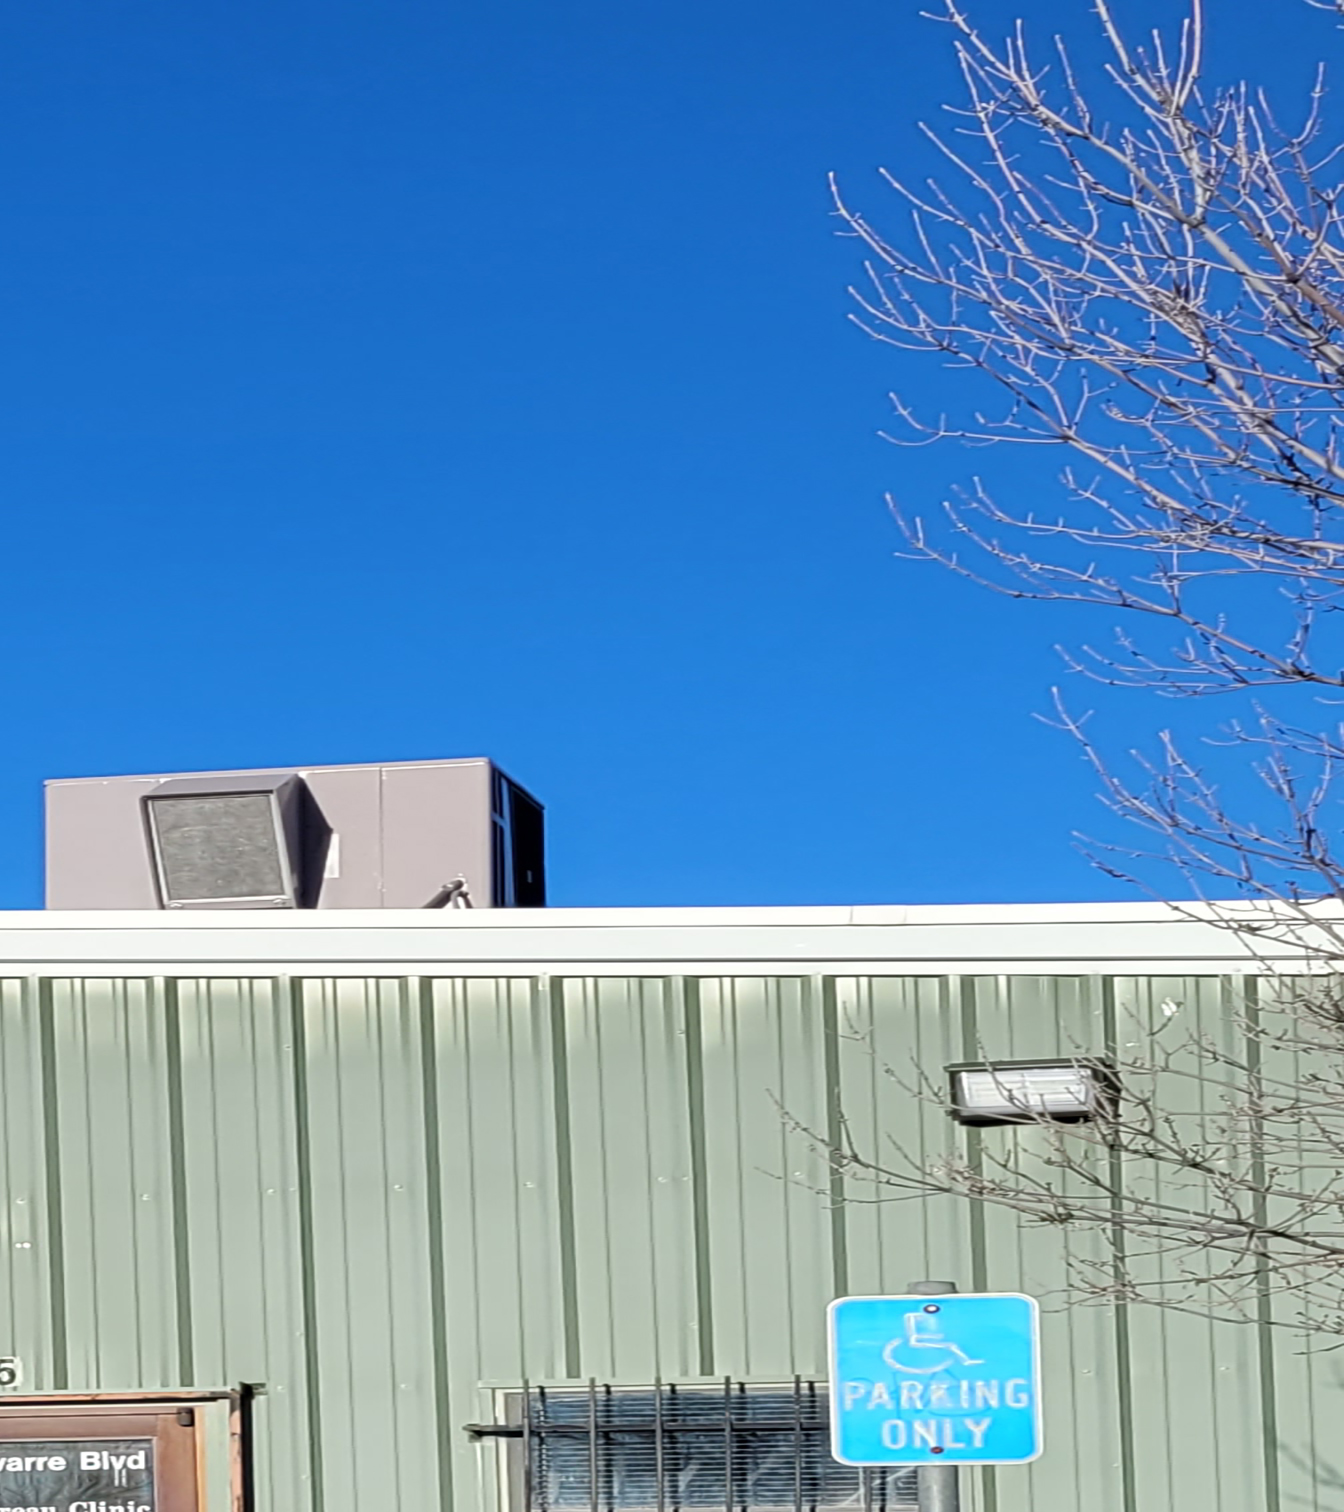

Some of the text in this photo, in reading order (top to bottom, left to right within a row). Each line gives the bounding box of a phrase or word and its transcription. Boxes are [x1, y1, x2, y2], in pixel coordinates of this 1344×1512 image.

[843, 1378, 1029, 1411] PARKING
[881, 1417, 992, 1450] ONLY
[80, 1450, 146, 1471] Blvd
